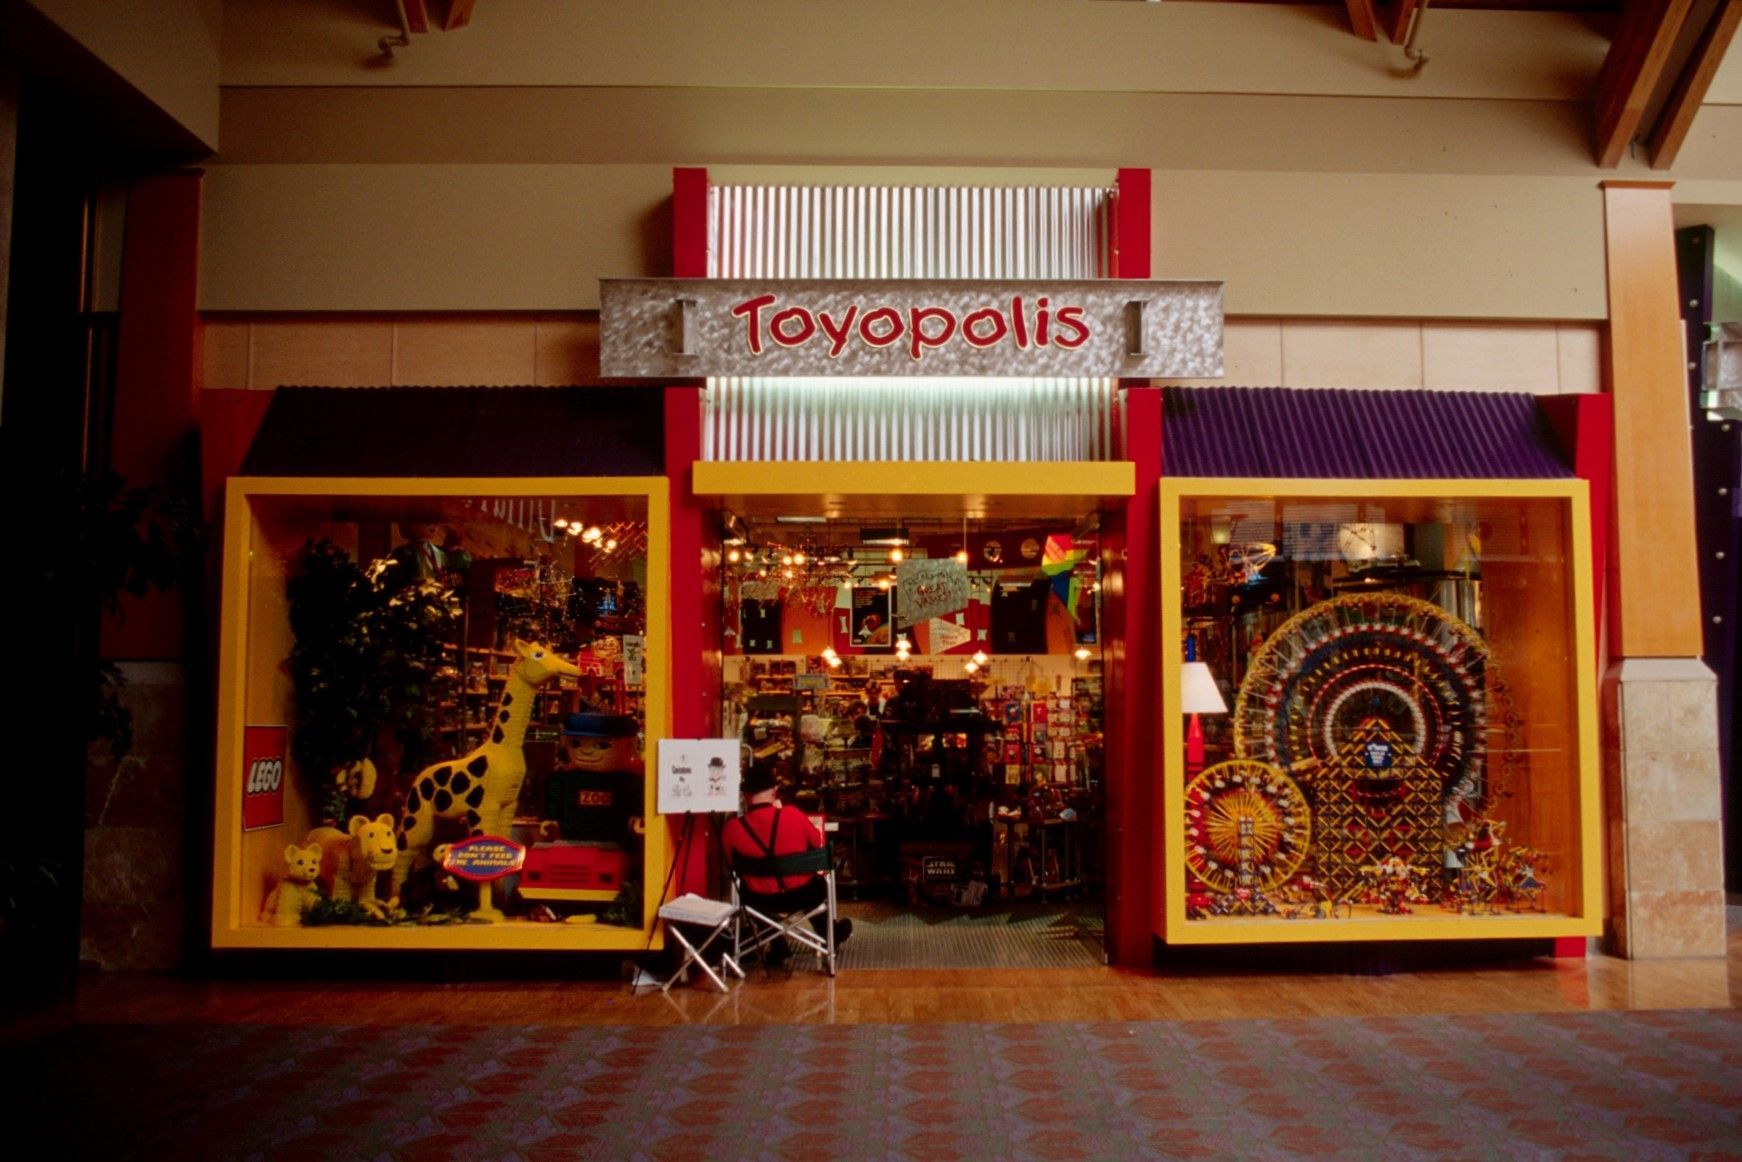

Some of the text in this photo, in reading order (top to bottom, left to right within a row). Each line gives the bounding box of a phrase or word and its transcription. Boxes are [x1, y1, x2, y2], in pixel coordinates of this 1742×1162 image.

[731, 293, 1092, 361] Toyopolis
[247, 759, 283, 794] LEGO
[580, 790, 612, 806] ZOO
[457, 851, 486, 859] DON'T
[472, 859, 517, 867] ANIMALS
